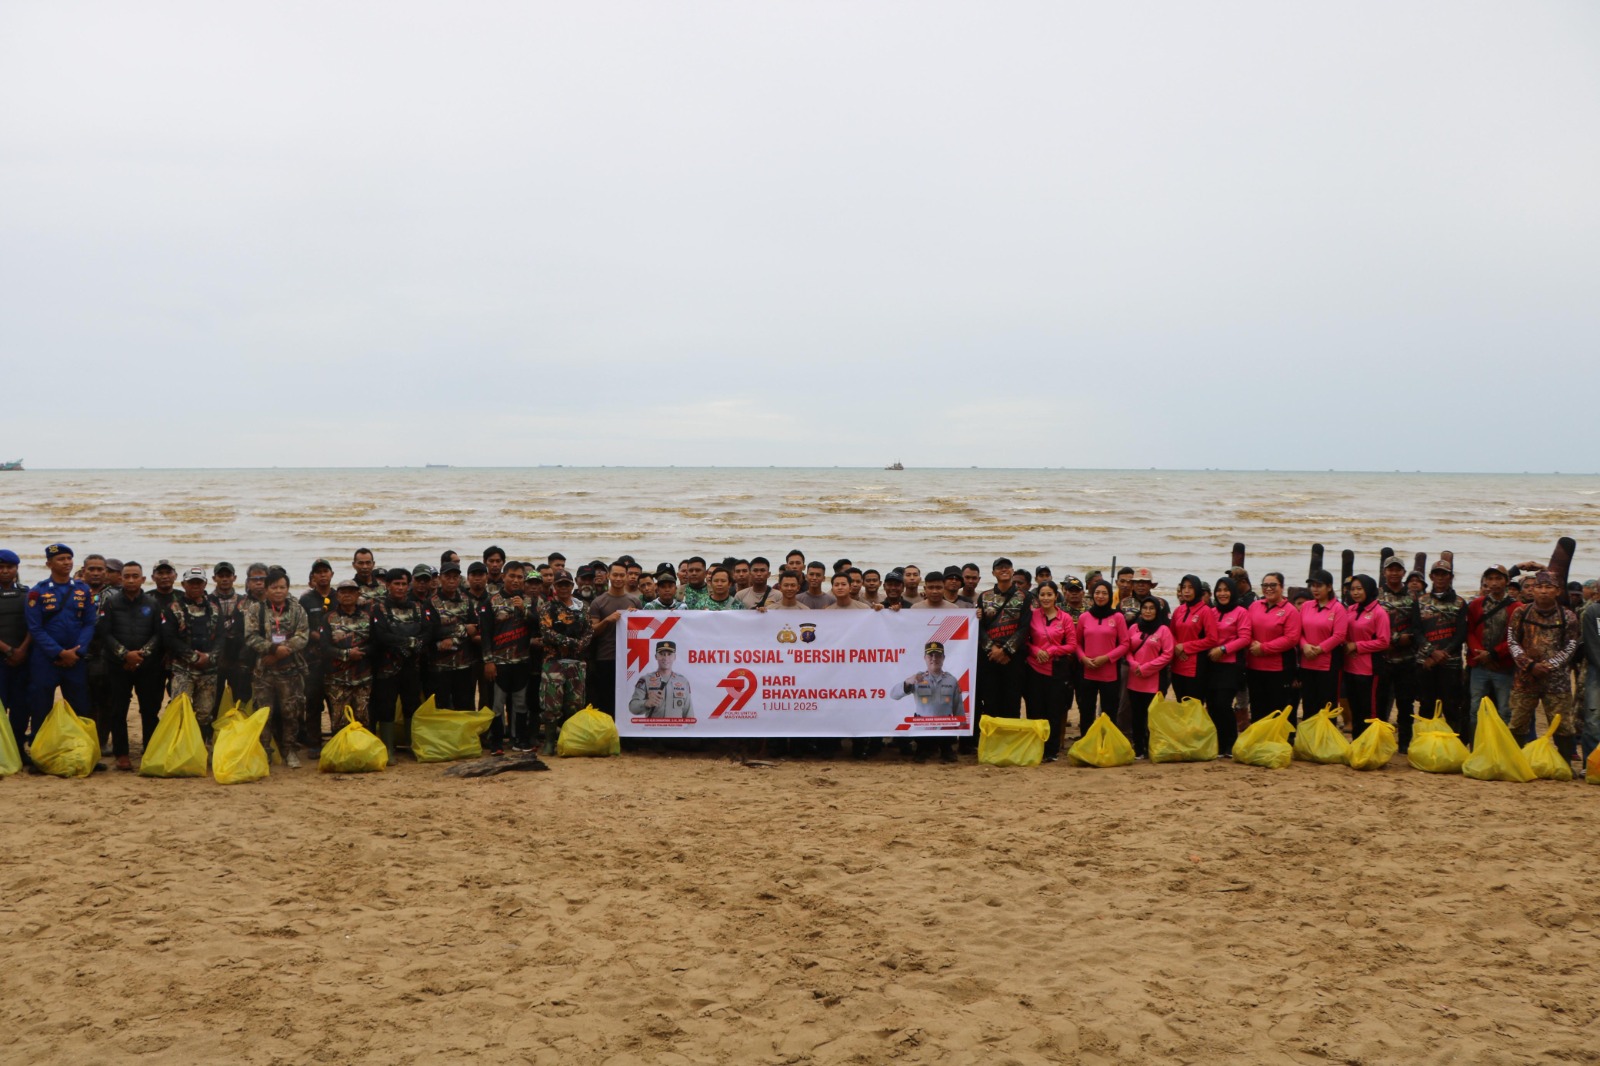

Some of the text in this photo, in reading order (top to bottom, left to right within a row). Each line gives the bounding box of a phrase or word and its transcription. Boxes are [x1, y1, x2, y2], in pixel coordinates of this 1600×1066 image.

[688, 648, 906, 664] BAKTI SOSIAL "BERSIH PANTAI"
[762, 675, 796, 686] HARI
[762, 688, 886, 700] BHAYANGKARA 79
[762, 701, 818, 711] 1 JULI 2025
